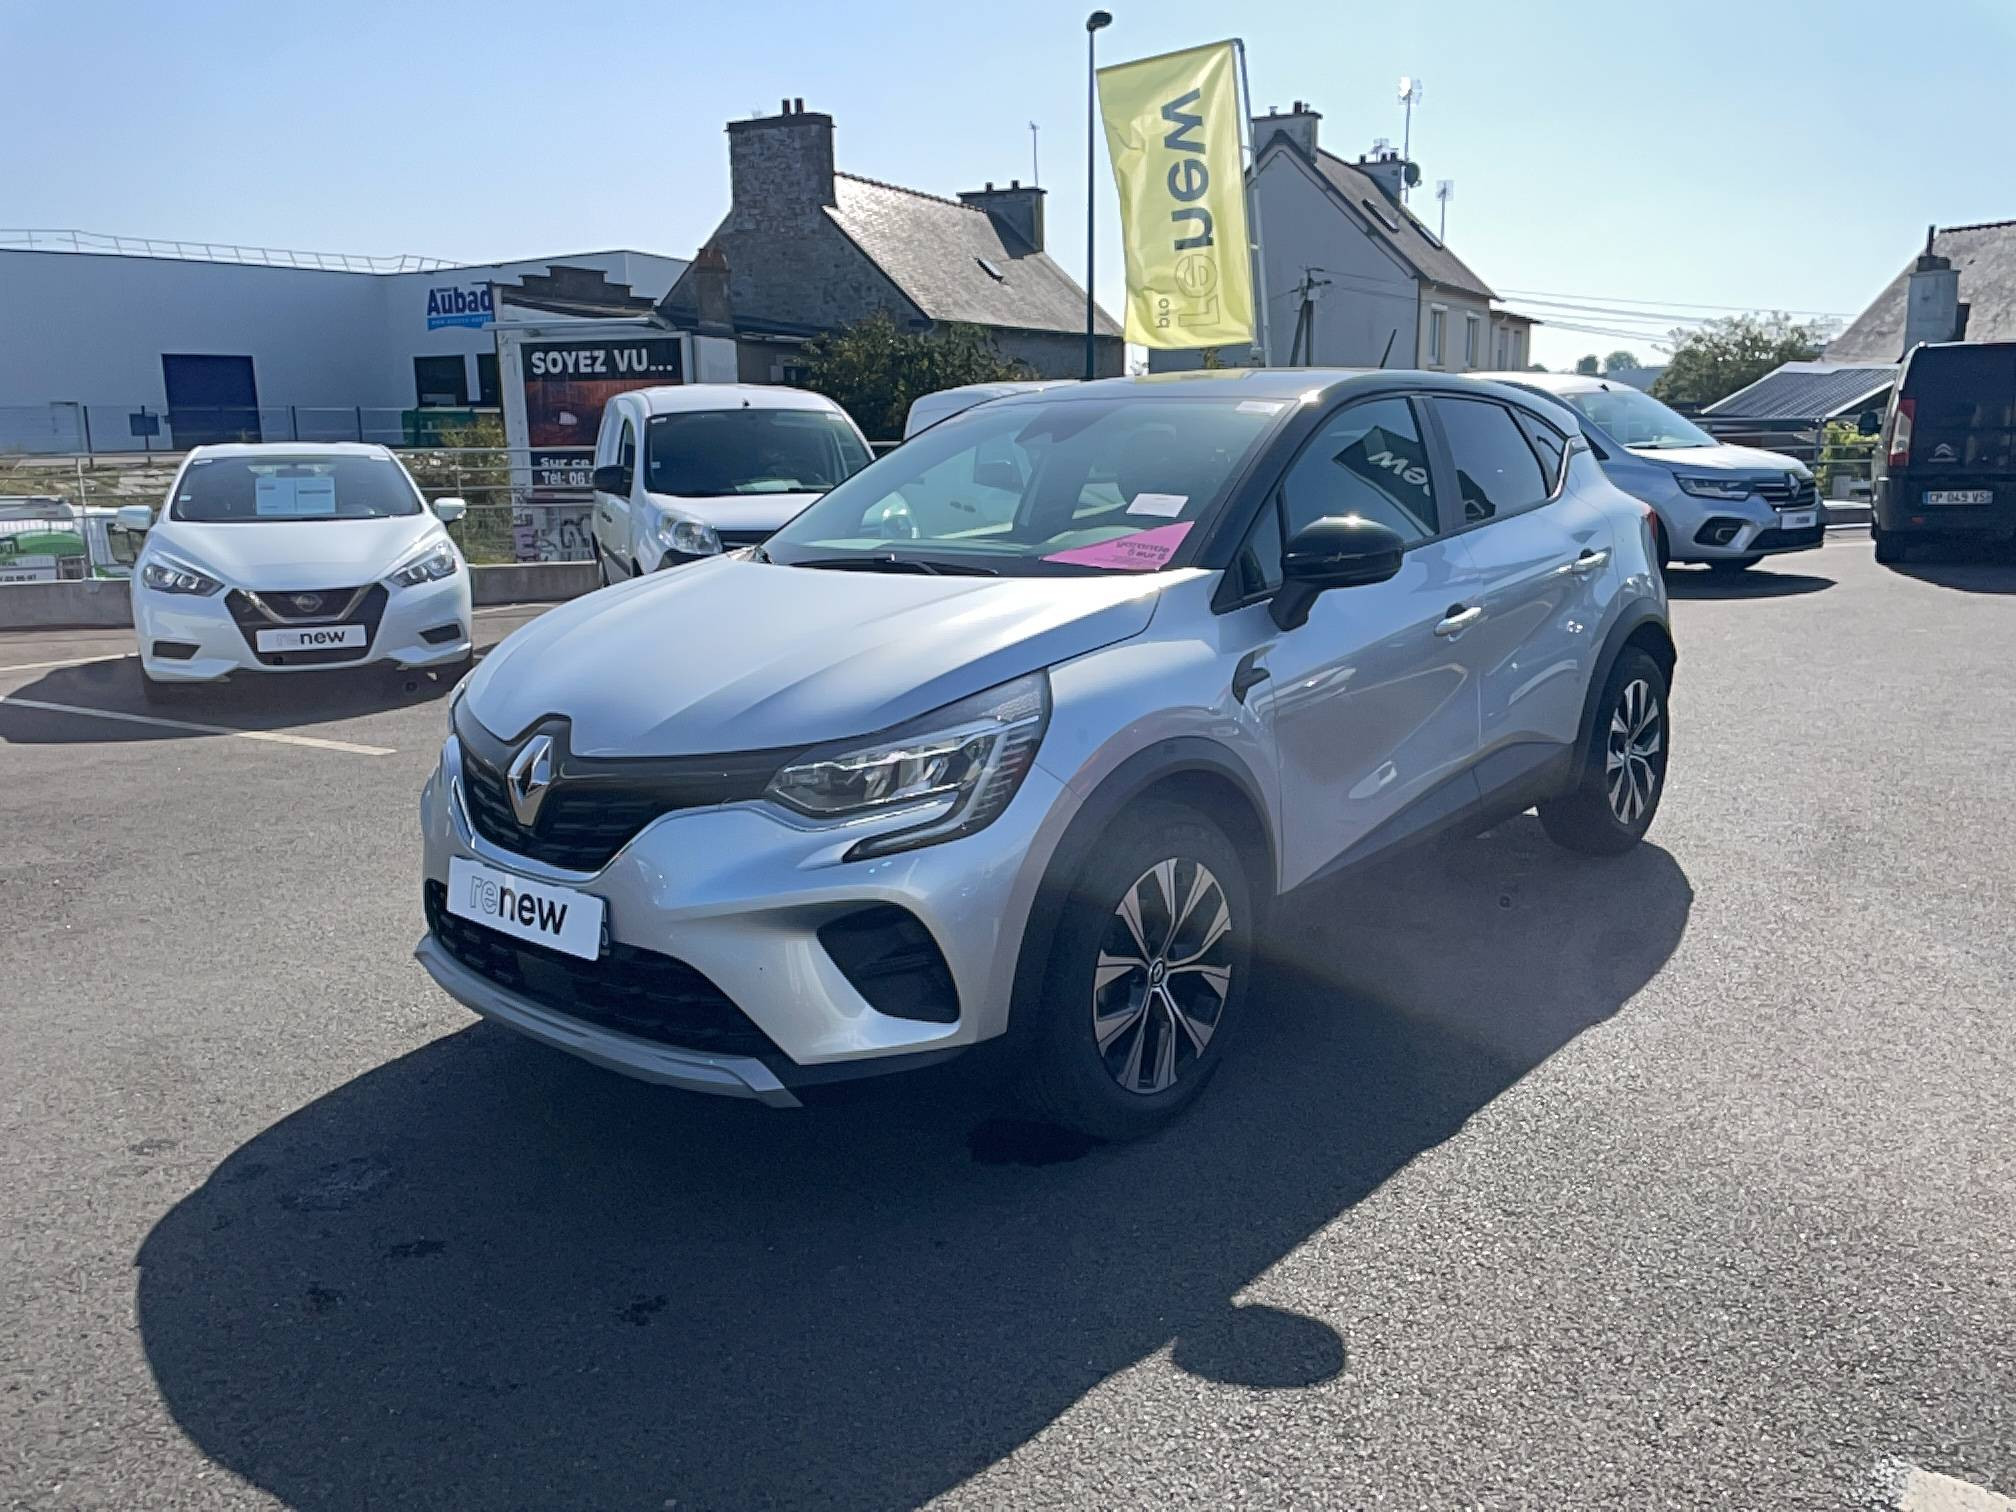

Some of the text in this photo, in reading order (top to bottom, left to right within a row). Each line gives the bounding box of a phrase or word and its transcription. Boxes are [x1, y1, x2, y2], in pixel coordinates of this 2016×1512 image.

[531, 348, 674, 375] SOYEZ VU...
[276, 628, 346, 648] renew
[470, 875, 568, 936] renew
